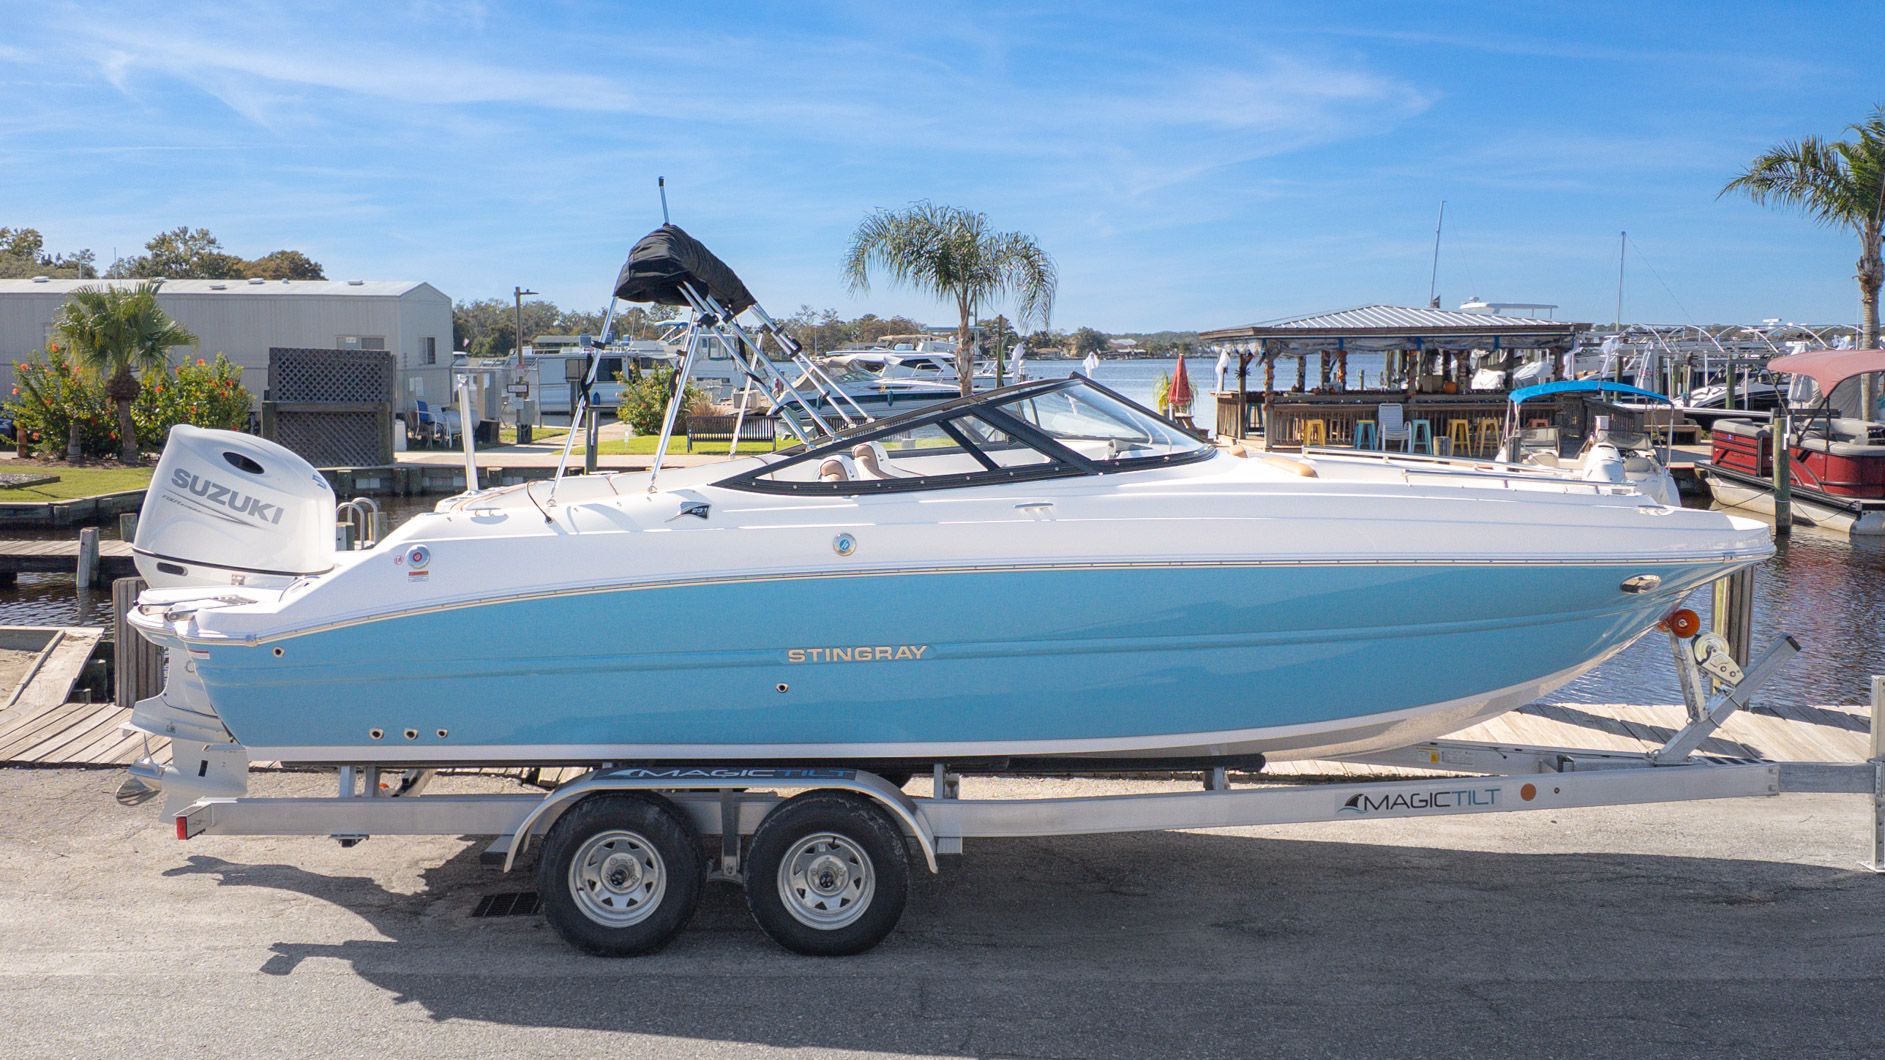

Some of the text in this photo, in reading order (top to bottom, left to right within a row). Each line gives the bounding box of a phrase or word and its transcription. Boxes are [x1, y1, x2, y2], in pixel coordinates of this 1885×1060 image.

[171, 468, 284, 525] SUZUKI
[788, 645, 927, 663] STINGRAY
[638, 768, 854, 778] MAGICTILT
[1364, 788, 1501, 811] MAGICTILT
